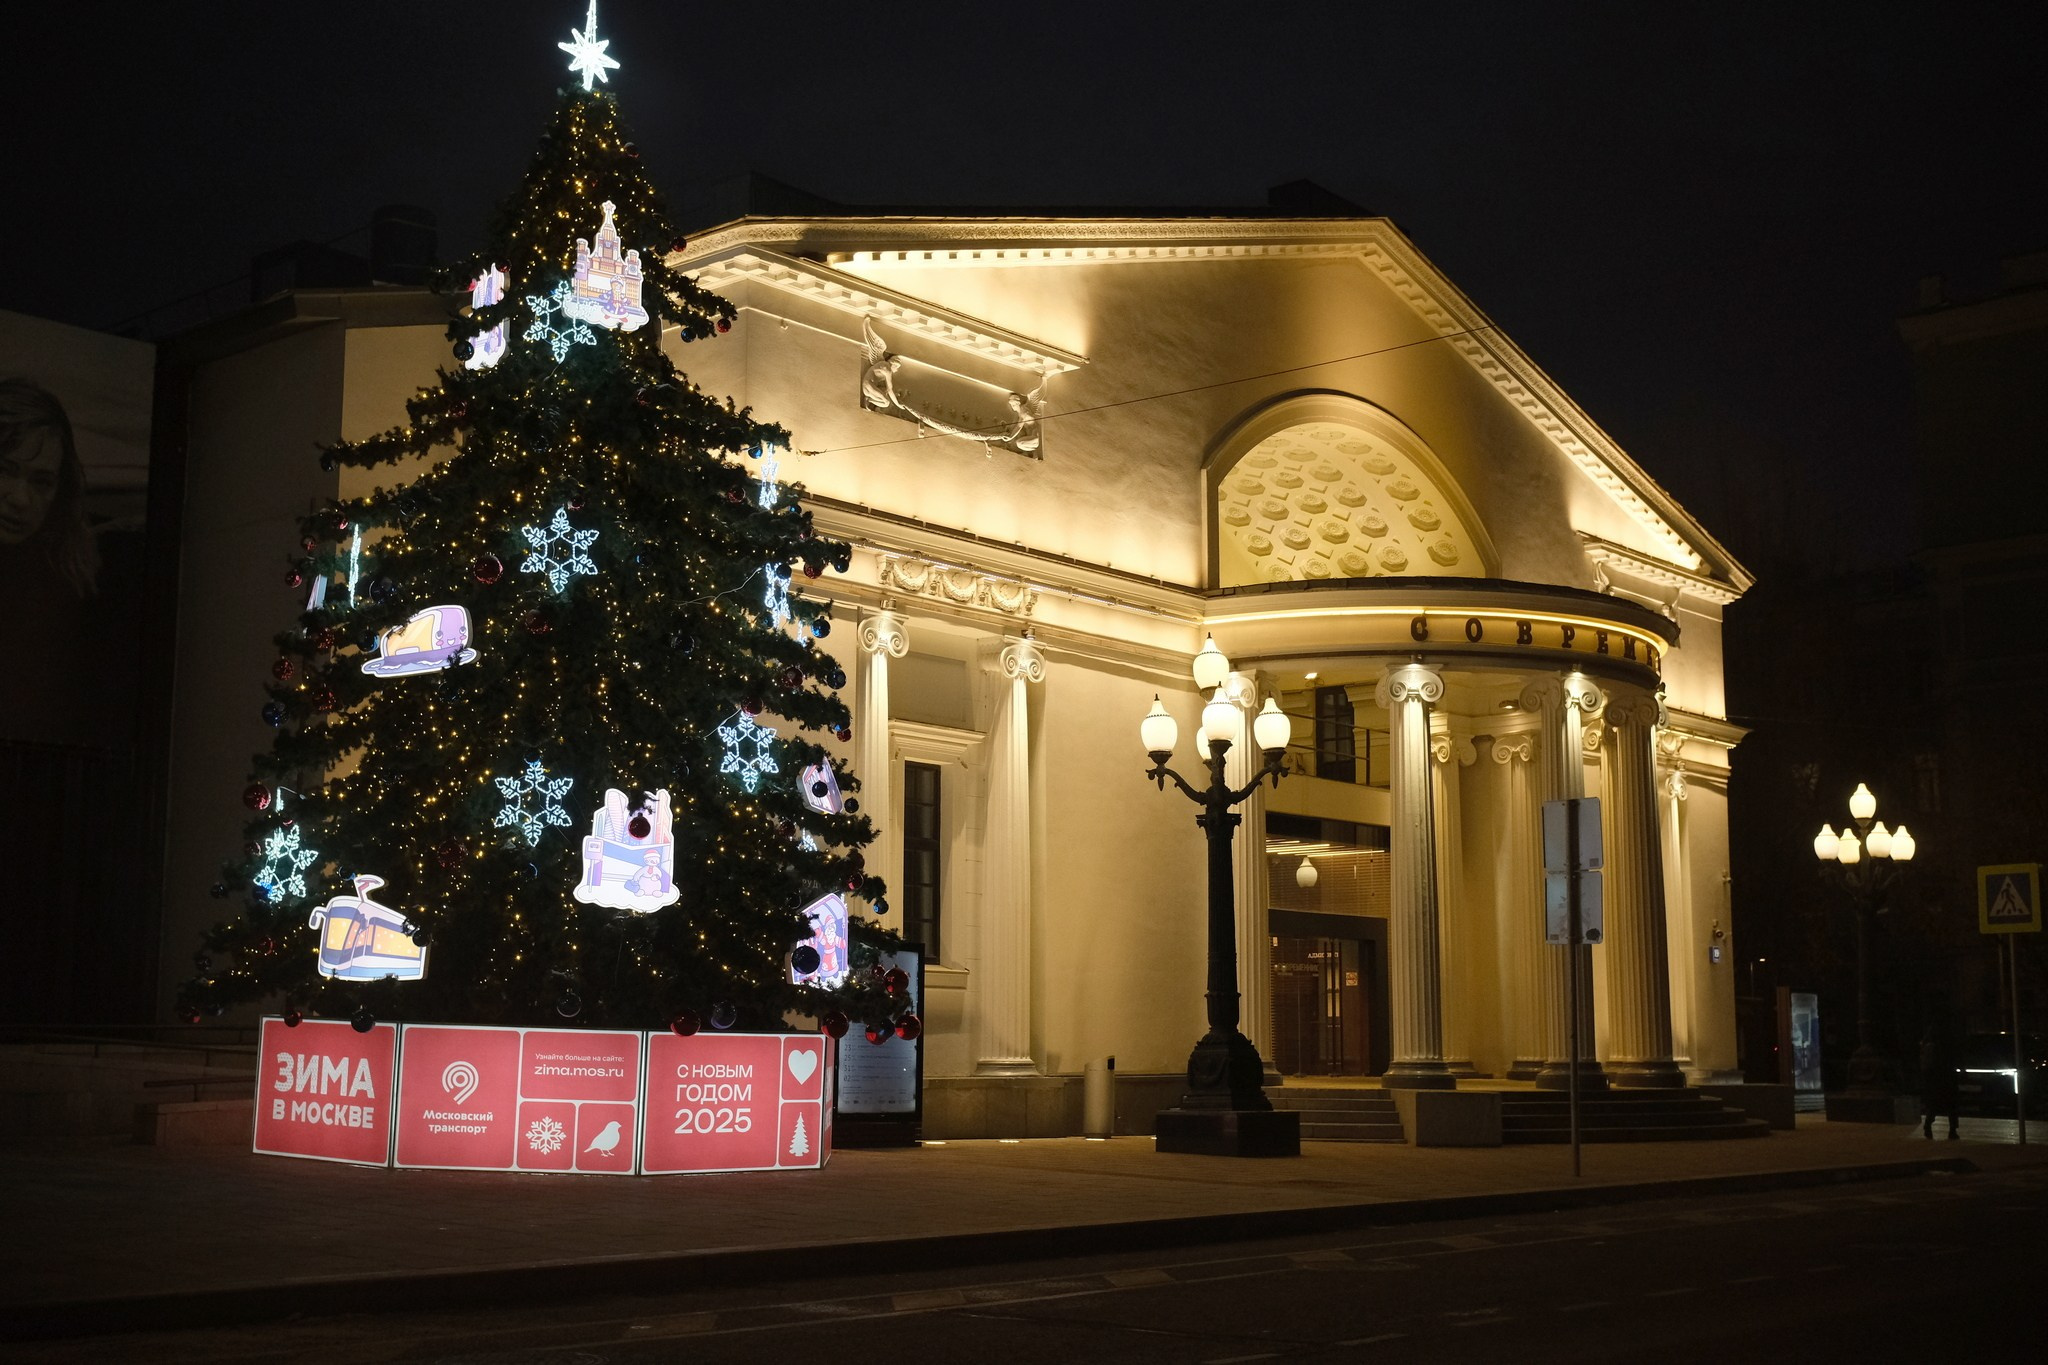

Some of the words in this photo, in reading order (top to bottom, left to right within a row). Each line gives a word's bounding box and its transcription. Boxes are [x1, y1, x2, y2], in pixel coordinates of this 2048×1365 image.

[535, 1053, 564, 1061] Узнайте
[274, 1052, 375, 1099] ЗИМА
[534, 1064, 624, 1077] zima.mos.ru
[677, 1064, 689, 1078] С
[692, 1064, 753, 1078] НОВЫМ
[676, 1083, 752, 1105] ГОДОМ
[272, 1098, 285, 1120] В
[291, 1100, 375, 1129] МОСКВЕ
[423, 1109, 494, 1121] Московский
[674, 1108, 752, 1134] 2025
[428, 1124, 488, 1135] транспорт
